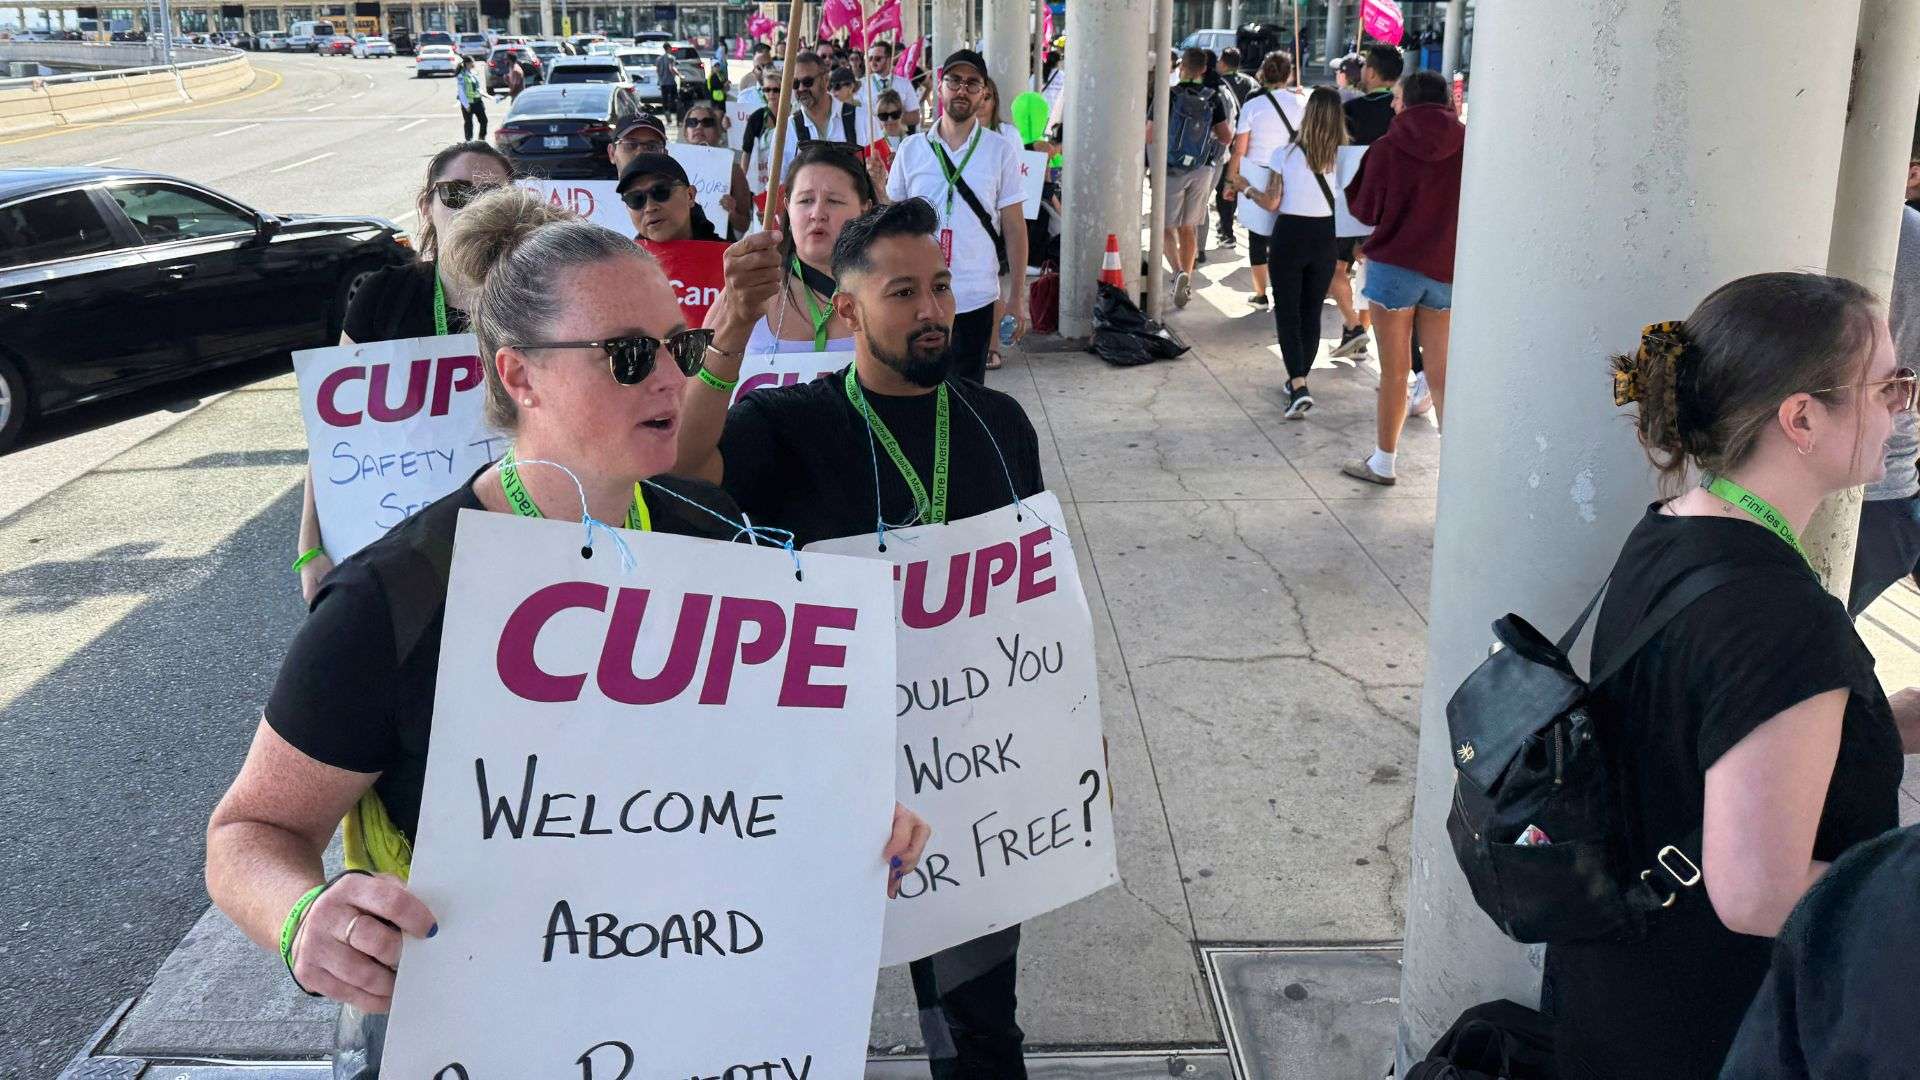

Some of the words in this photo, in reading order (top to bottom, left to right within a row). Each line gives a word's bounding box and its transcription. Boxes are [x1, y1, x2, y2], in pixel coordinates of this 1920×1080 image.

[528, 186, 595, 219] AID
[669, 279, 720, 306] Can
[316, 355, 486, 428] CUP
[938, 399, 949, 421] Fair
[329, 441, 455, 485] SAFETY
[468, 437, 504, 465] T
[510, 485, 537, 518] ract
[935, 478, 946, 507] More
[1738, 493, 1765, 514] Fini
[1763, 510, 1780, 528] les
[893, 525, 1057, 630] UPE
[496, 581, 859, 709] CUPE
[896, 667, 990, 717] OULD
[996, 633, 1064, 687] YOU
[903, 733, 1021, 794] WORK
[475, 753, 784, 840] WELCOME
[897, 853, 960, 899] OR
[972, 769, 1101, 878] FREE?
[542, 900, 764, 963] ABOARD
